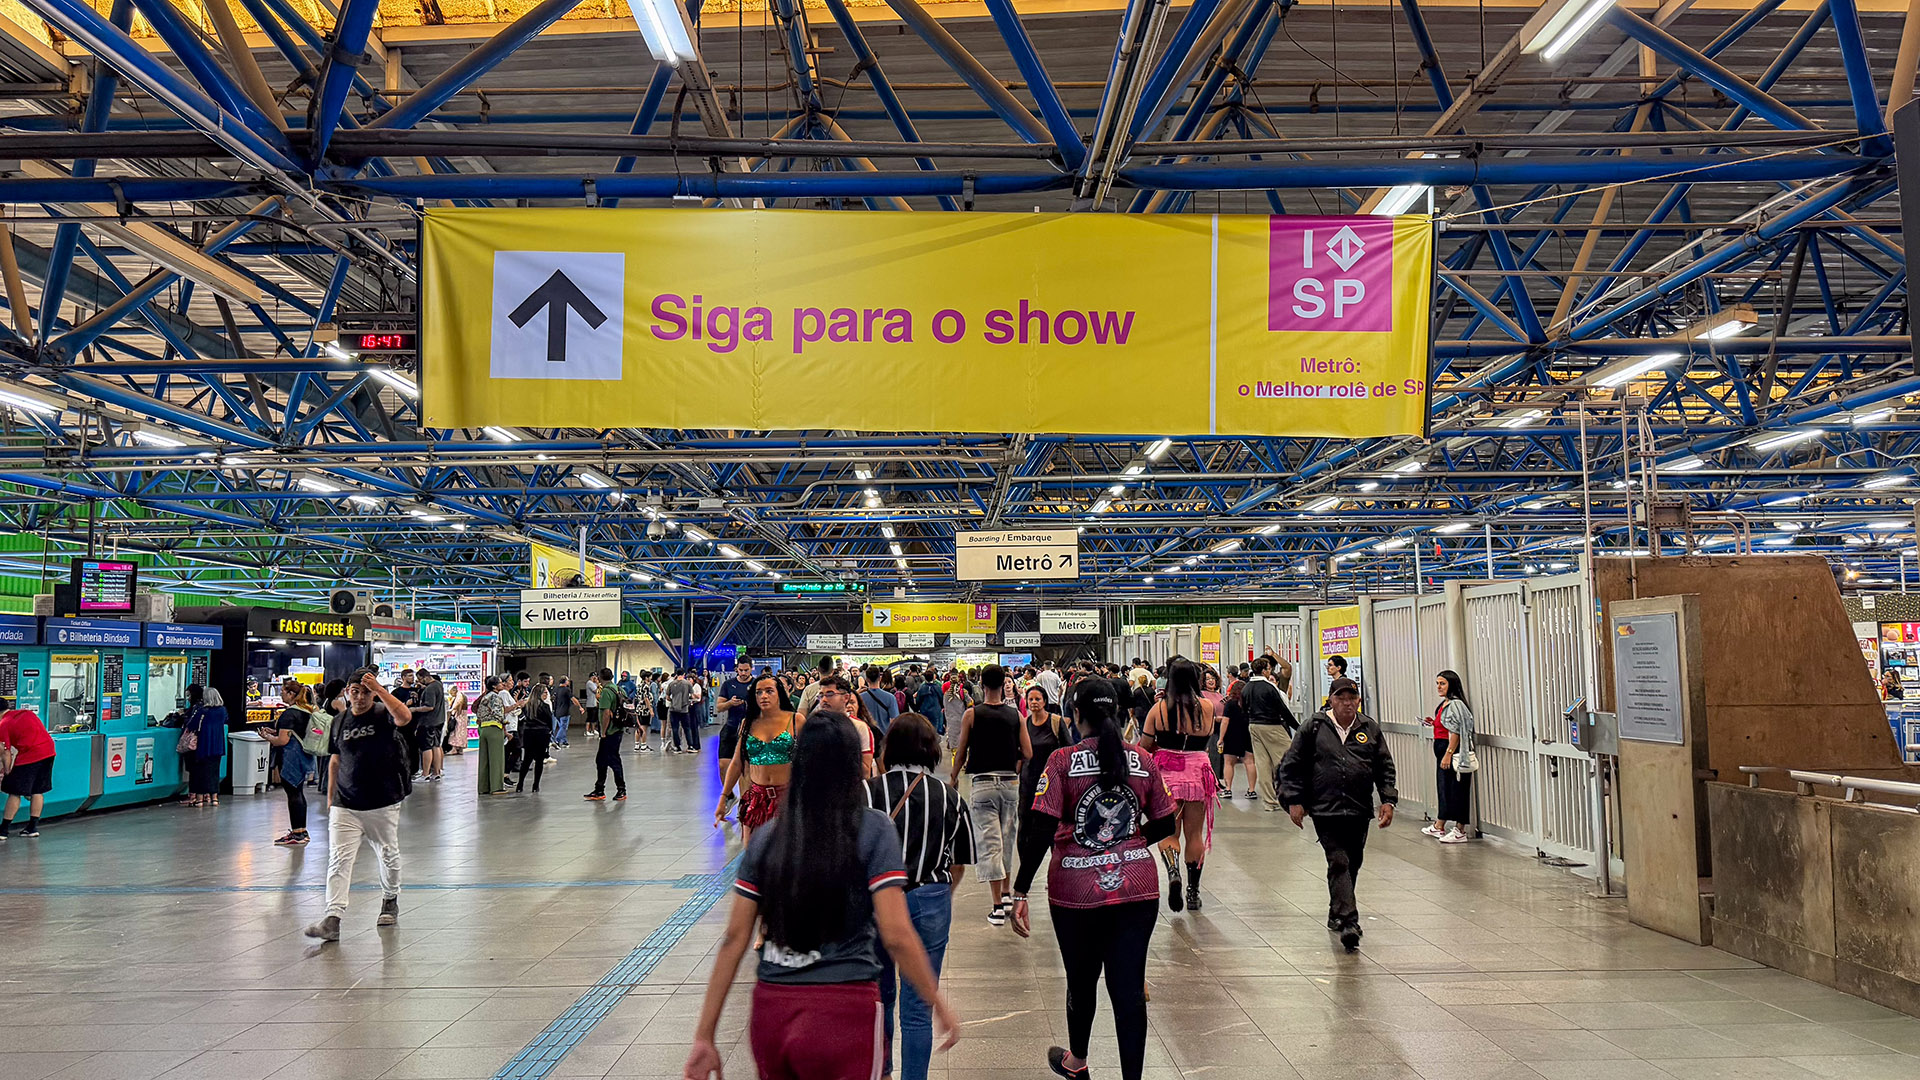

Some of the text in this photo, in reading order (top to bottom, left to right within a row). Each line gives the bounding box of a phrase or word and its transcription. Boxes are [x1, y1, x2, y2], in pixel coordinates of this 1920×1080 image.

[1291, 277, 1366, 319] SP
[650, 293, 1136, 354] Siga para o show
[361, 334, 402, 348] 16:47
[1300, 357, 1361, 374] Metrô:
[1237, 378, 1424, 398] o Melhor rolê de SP
[968, 535, 1000, 544] Boarding
[1007, 533, 1052, 543] Embarque
[996, 553, 1053, 571] Metrô
[543, 606, 590, 621] Metrô
[893, 614, 910, 623] Siga
[937, 614, 958, 622] show
[279, 618, 344, 637] FAST COFFEE
[1058, 621, 1087, 630] Metrô
[70, 631, 130, 643] Bilheteria Blindada
[166, 636, 214, 646] Bilheteria Blindada
[342, 725, 375, 741] BOSS
[1062, 853, 1121, 868] CARNAVAL
